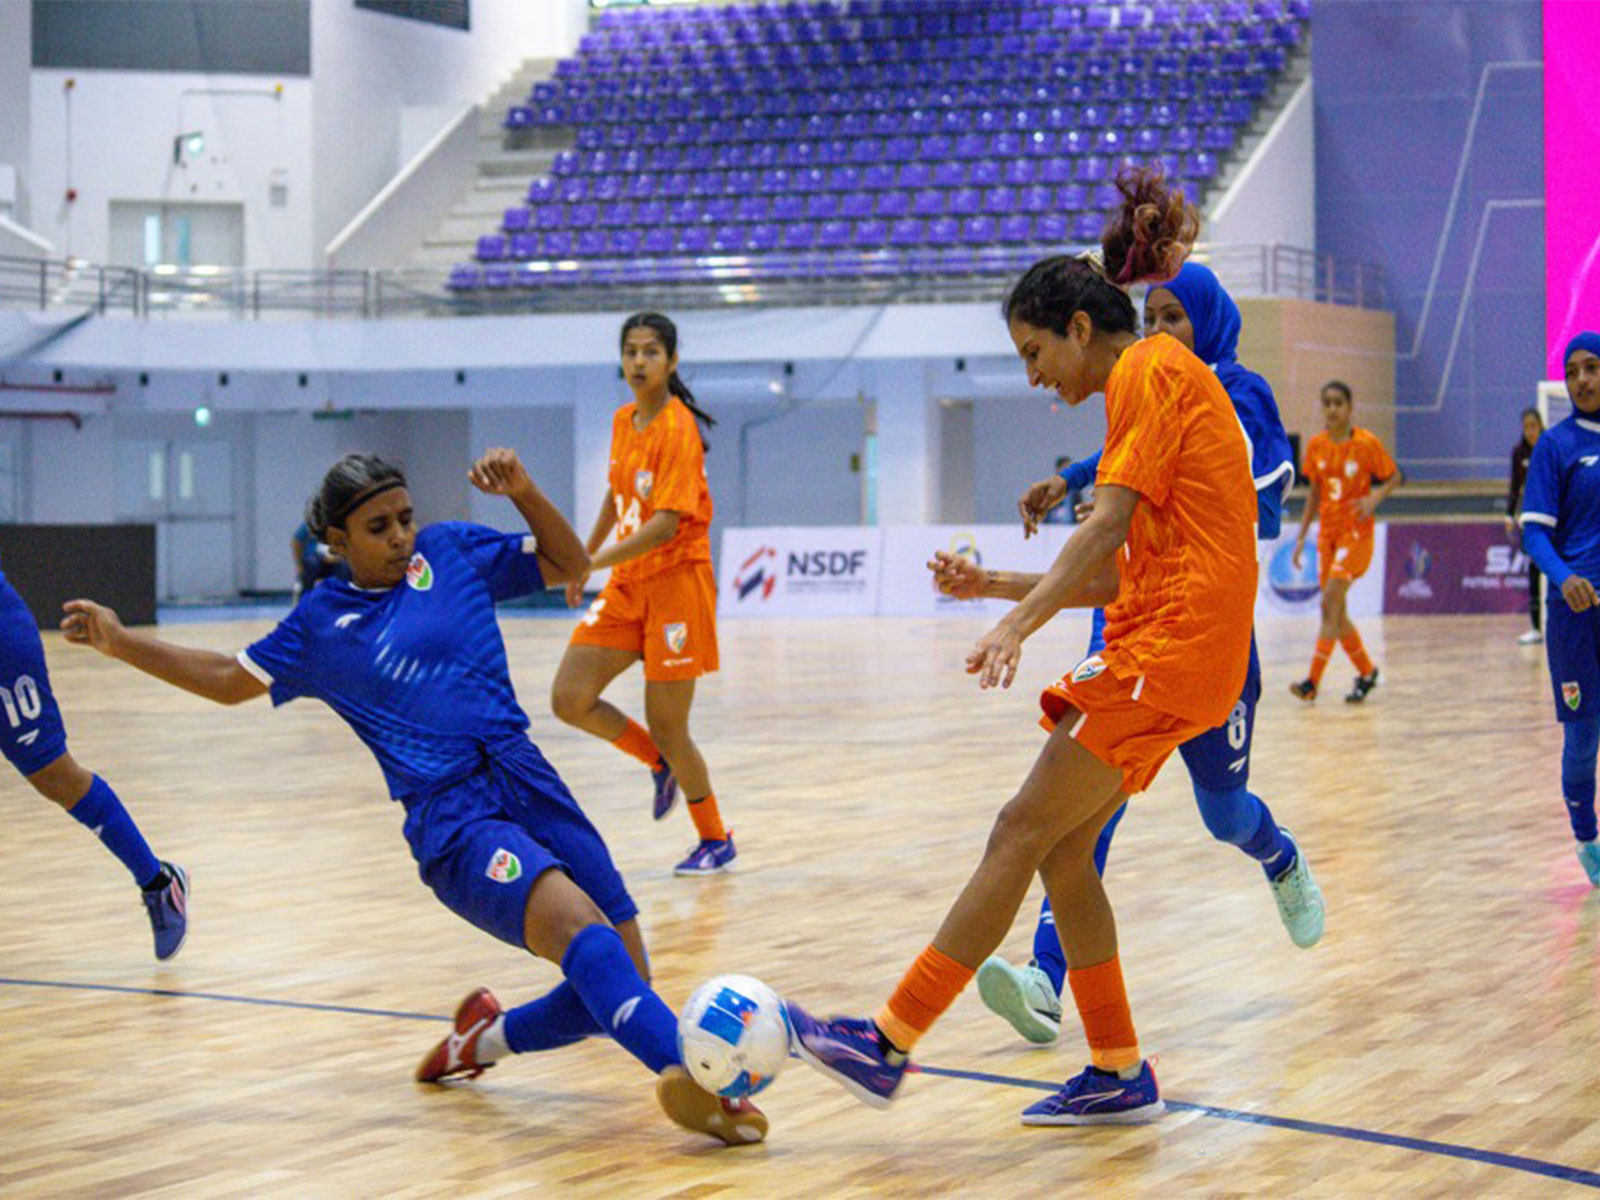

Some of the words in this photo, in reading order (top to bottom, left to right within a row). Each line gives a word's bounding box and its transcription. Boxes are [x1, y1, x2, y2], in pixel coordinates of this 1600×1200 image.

[1329, 477, 1342, 500] 3
[787, 551, 866, 576] NSDF
[0, 674, 42, 728] 10
[1227, 699, 1247, 750] 8
